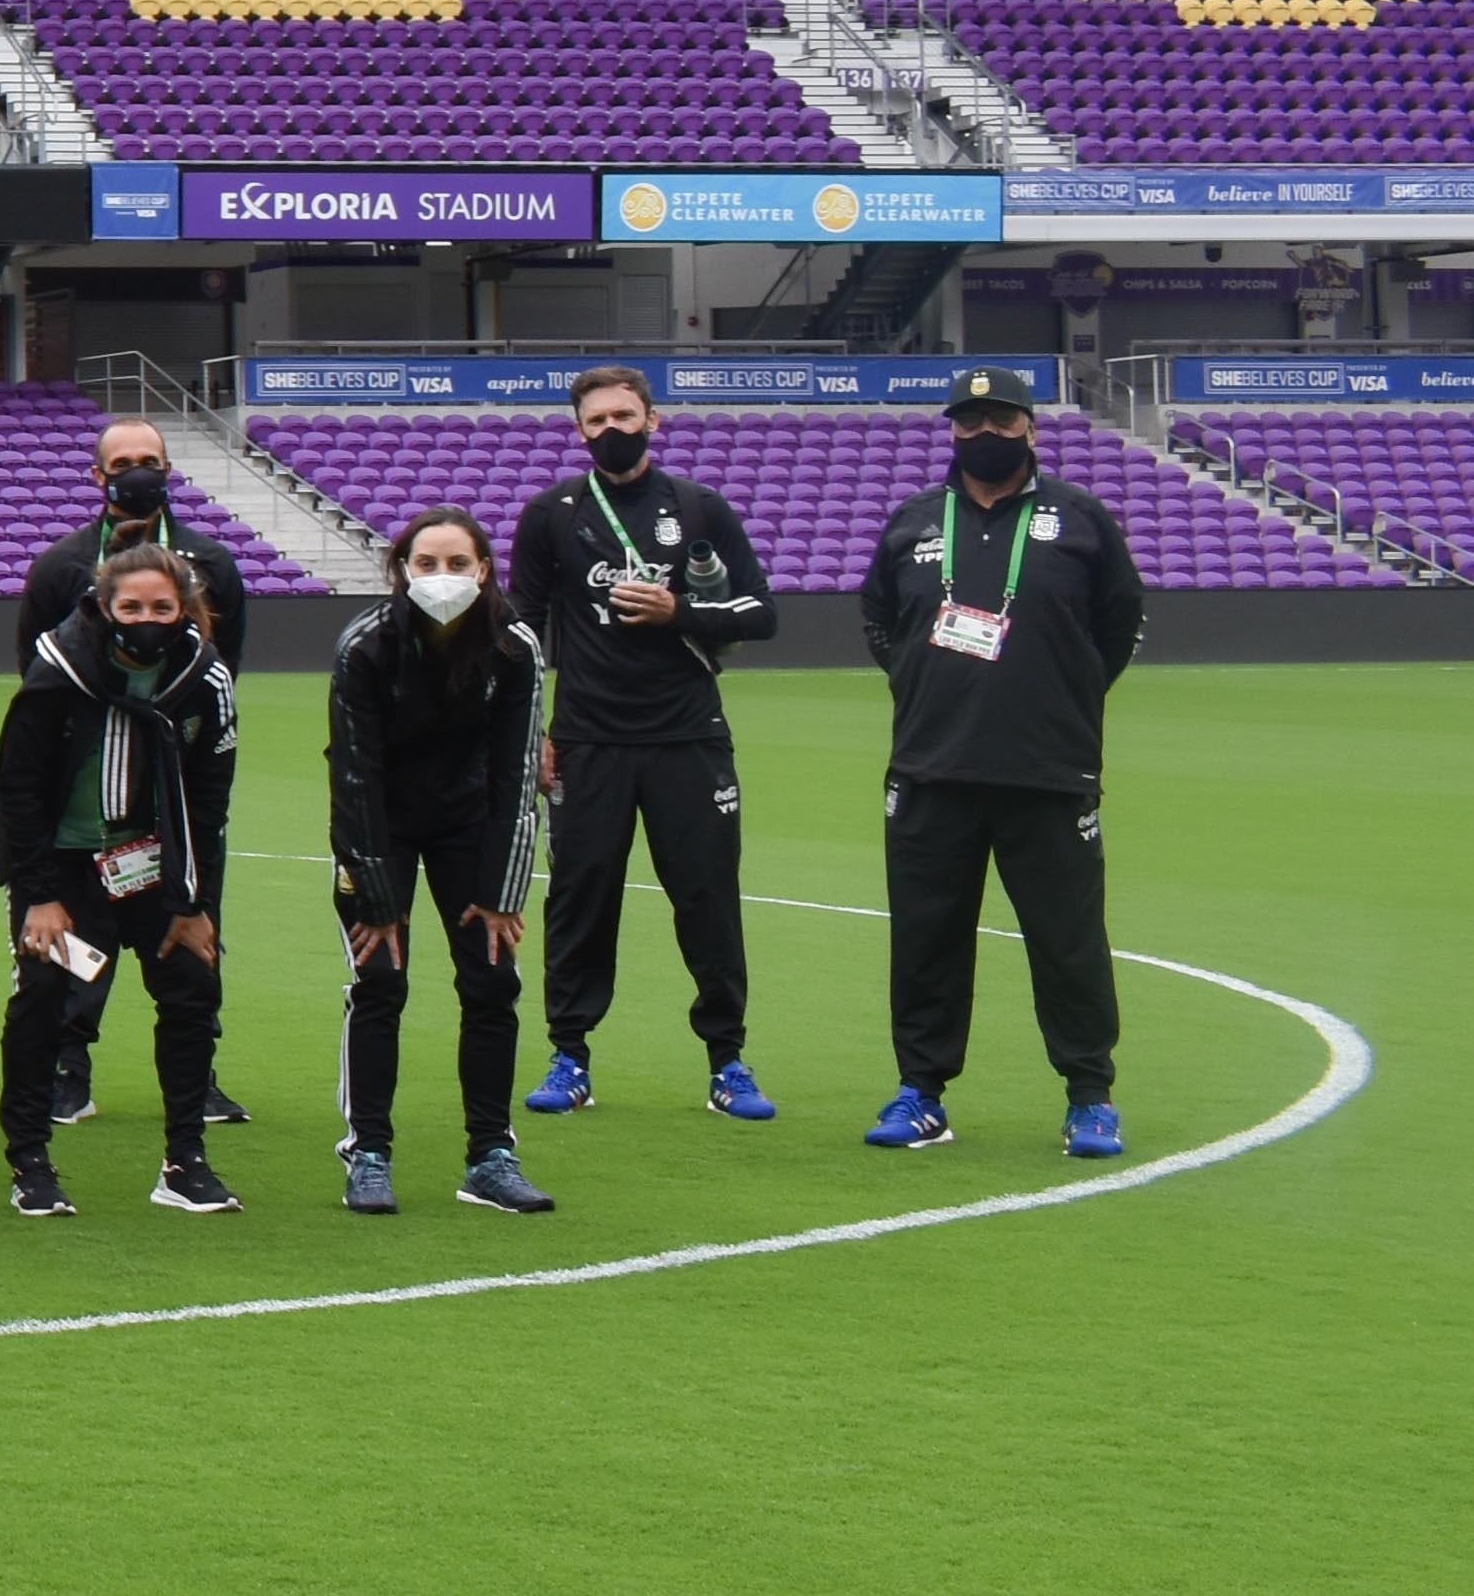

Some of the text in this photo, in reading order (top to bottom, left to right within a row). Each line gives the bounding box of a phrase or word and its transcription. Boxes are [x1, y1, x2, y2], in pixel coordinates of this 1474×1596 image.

[836, 69, 873, 88] 136
[1101, 183, 1129, 199] CUP
[1139, 188, 1175, 204] VISA
[1208, 185, 1272, 203] believe
[1291, 183, 1355, 203] YOURSELF
[220, 182, 555, 221] EXPLORIA STADIUM
[672, 208, 794, 222] CLEARWATER
[864, 208, 986, 222] CLEARWATER
[368, 372, 399, 389] CUP
[410, 376, 453, 394] VISA
[486, 376, 544, 395] aspire
[546, 371, 563, 389] TO
[775, 370, 807, 387] CUP
[817, 376, 860, 393] VISA
[888, 375, 950, 393] pursue
[1309, 370, 1338, 387] CUP
[1348, 376, 1388, 391] VISA
